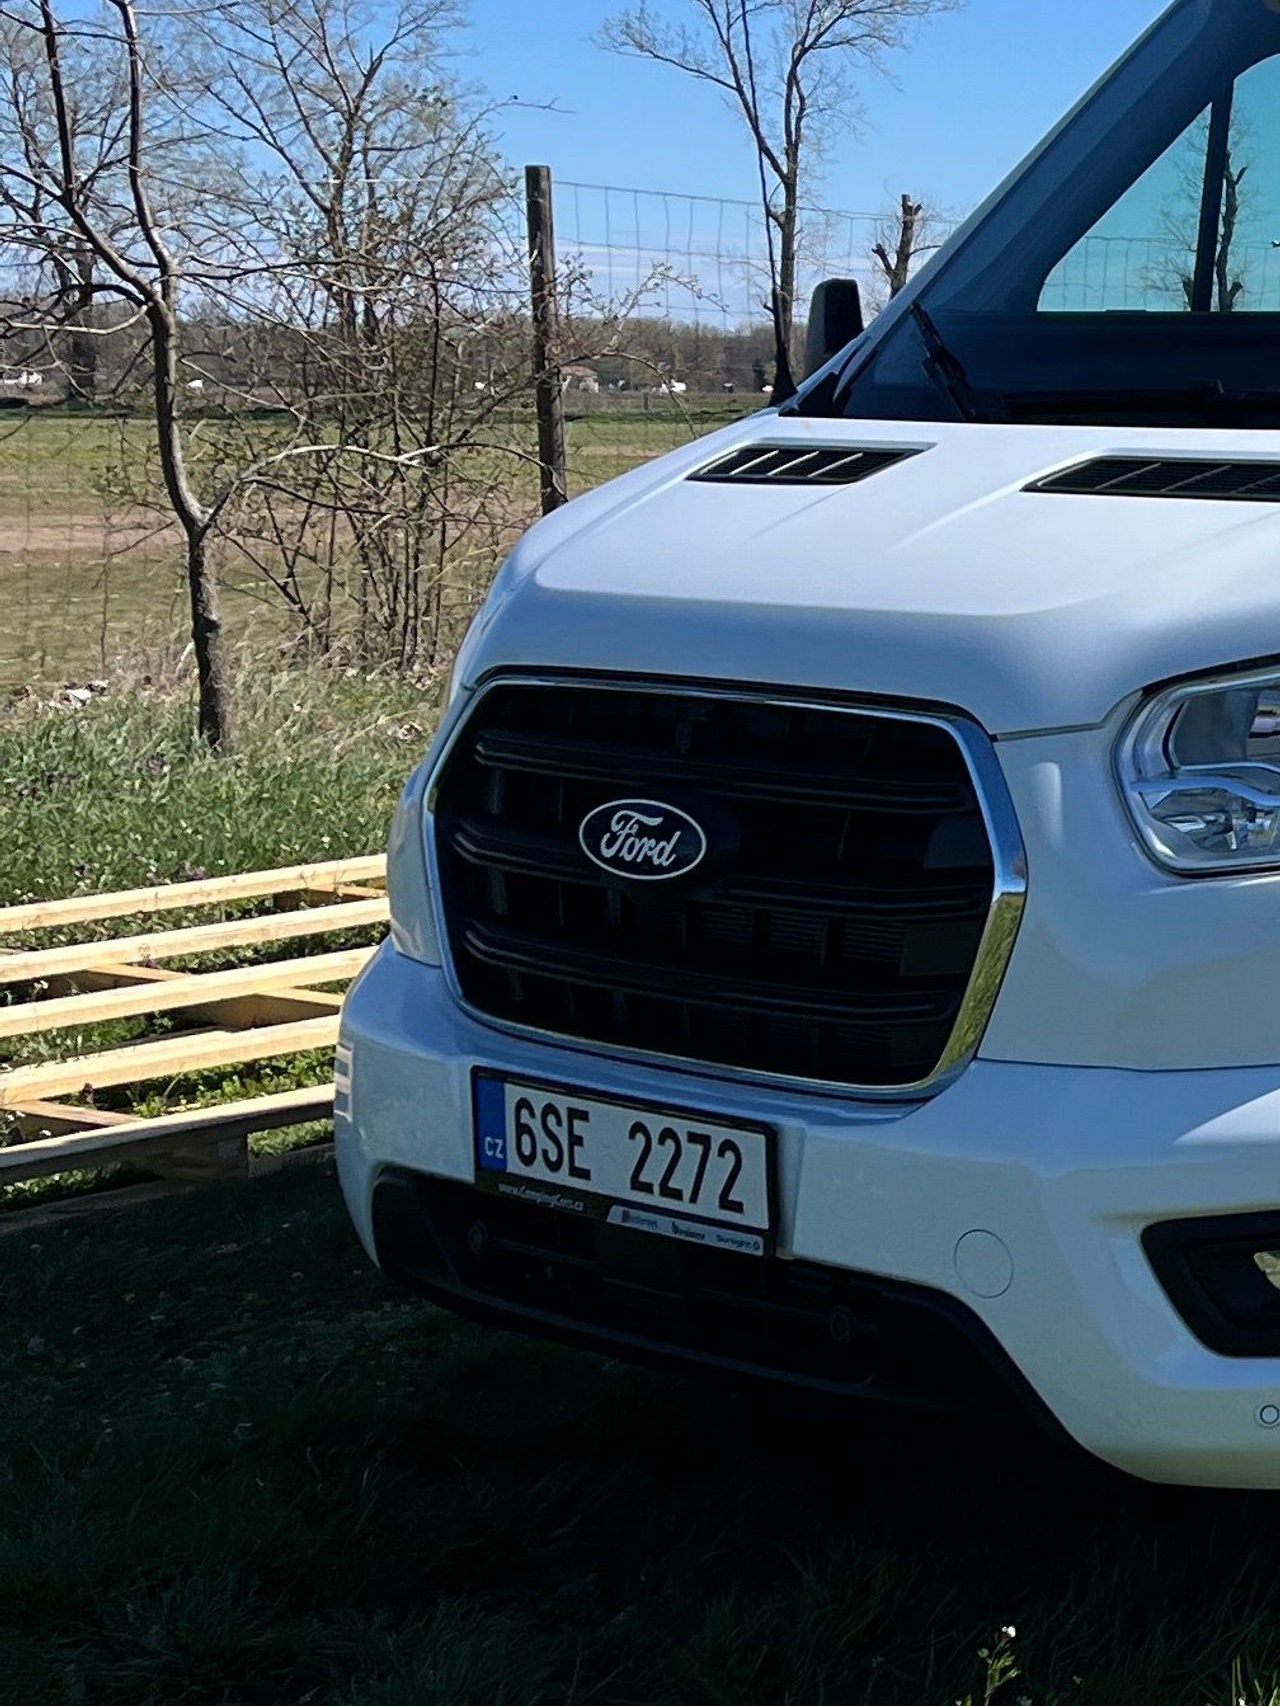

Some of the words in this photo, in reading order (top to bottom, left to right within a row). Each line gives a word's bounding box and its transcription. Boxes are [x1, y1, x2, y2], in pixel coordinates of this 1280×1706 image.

[600, 810, 682, 867] Ford
[484, 1136, 504, 1159] CZ
[514, 1097, 592, 1181] 6SE
[628, 1121, 745, 1215] 2272
